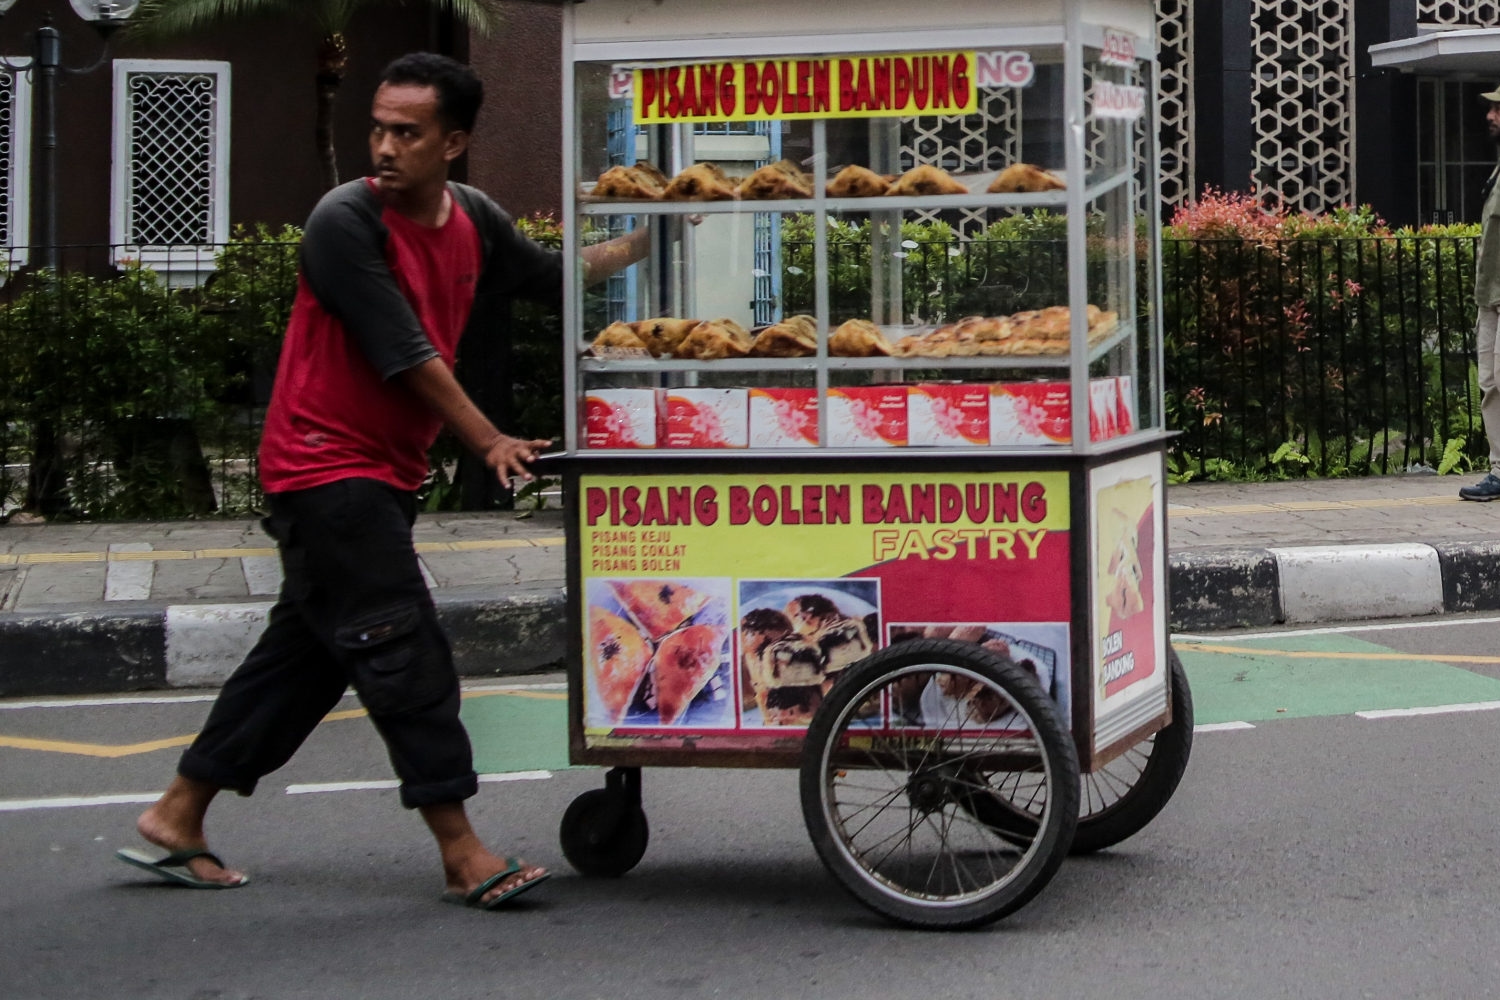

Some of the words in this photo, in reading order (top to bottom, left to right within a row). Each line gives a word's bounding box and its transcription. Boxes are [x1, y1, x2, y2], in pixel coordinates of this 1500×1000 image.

[641, 62, 737, 119] PISANG
[744, 58, 831, 115] BOLEN
[838, 52, 970, 112] BANDUNG
[586, 485, 719, 527] PISANG
[729, 483, 851, 526] BOLEN
[862, 481, 1048, 525] BANDUNG
[591, 530, 637, 543] PISANG
[641, 530, 671, 543] KEJU
[872, 528, 1048, 562] FASTRY
[591, 544, 637, 557] PISANG
[641, 544, 687, 557] COKLAT
[591, 559, 637, 572] PISANG
[641, 559, 681, 572] BOLEN
